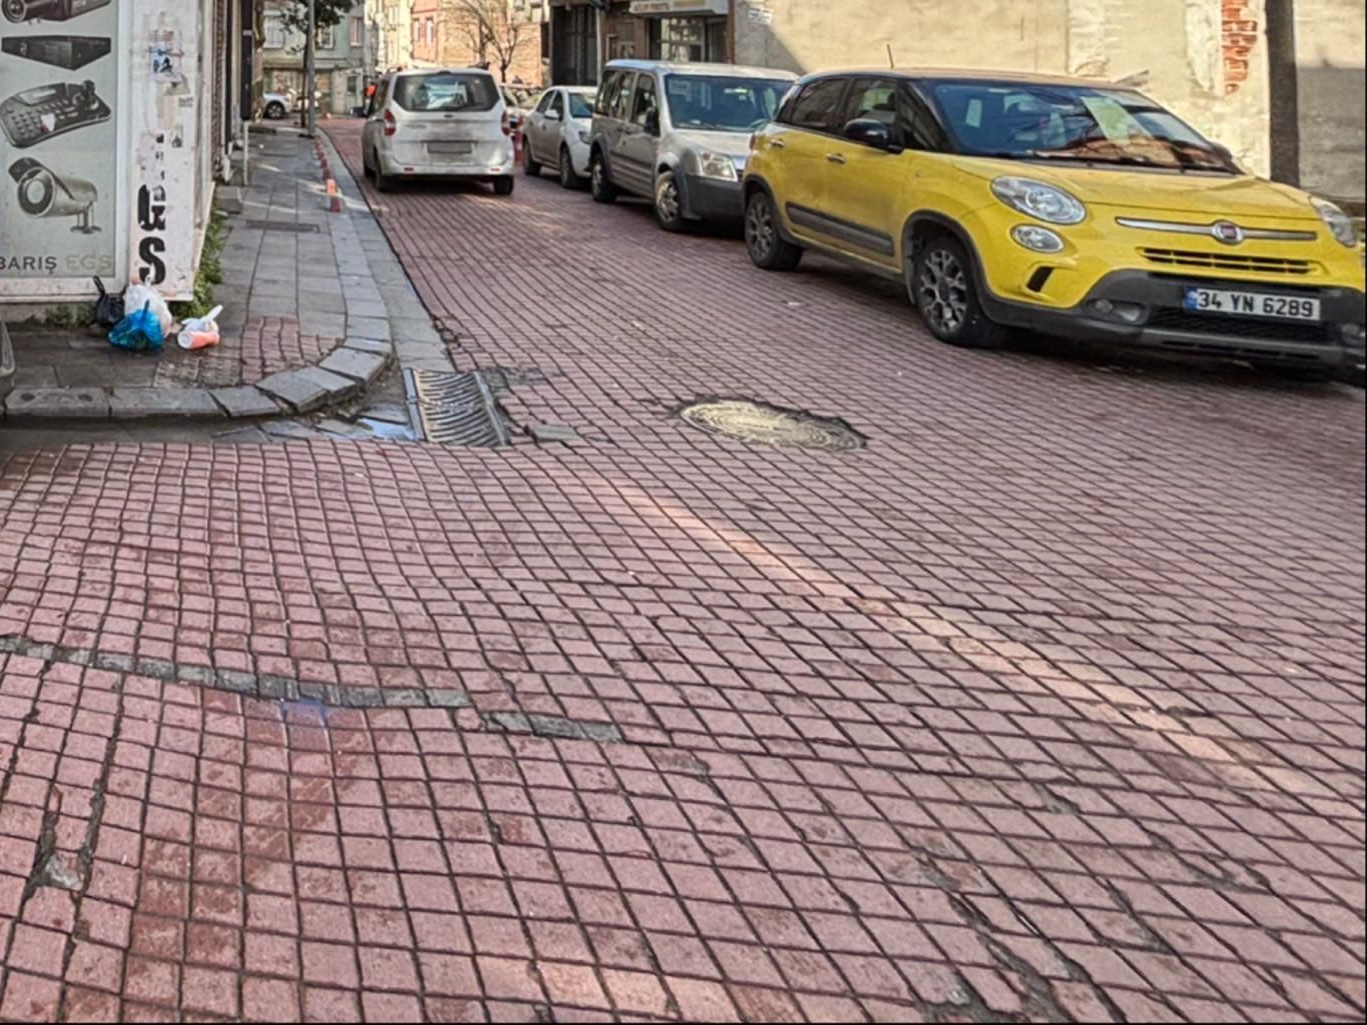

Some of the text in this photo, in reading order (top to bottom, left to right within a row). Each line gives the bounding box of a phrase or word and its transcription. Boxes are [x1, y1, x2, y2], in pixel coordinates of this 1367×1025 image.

[65, 255, 113, 271] EGS
[1198, 291, 1313, 318] 34 YN 6289
